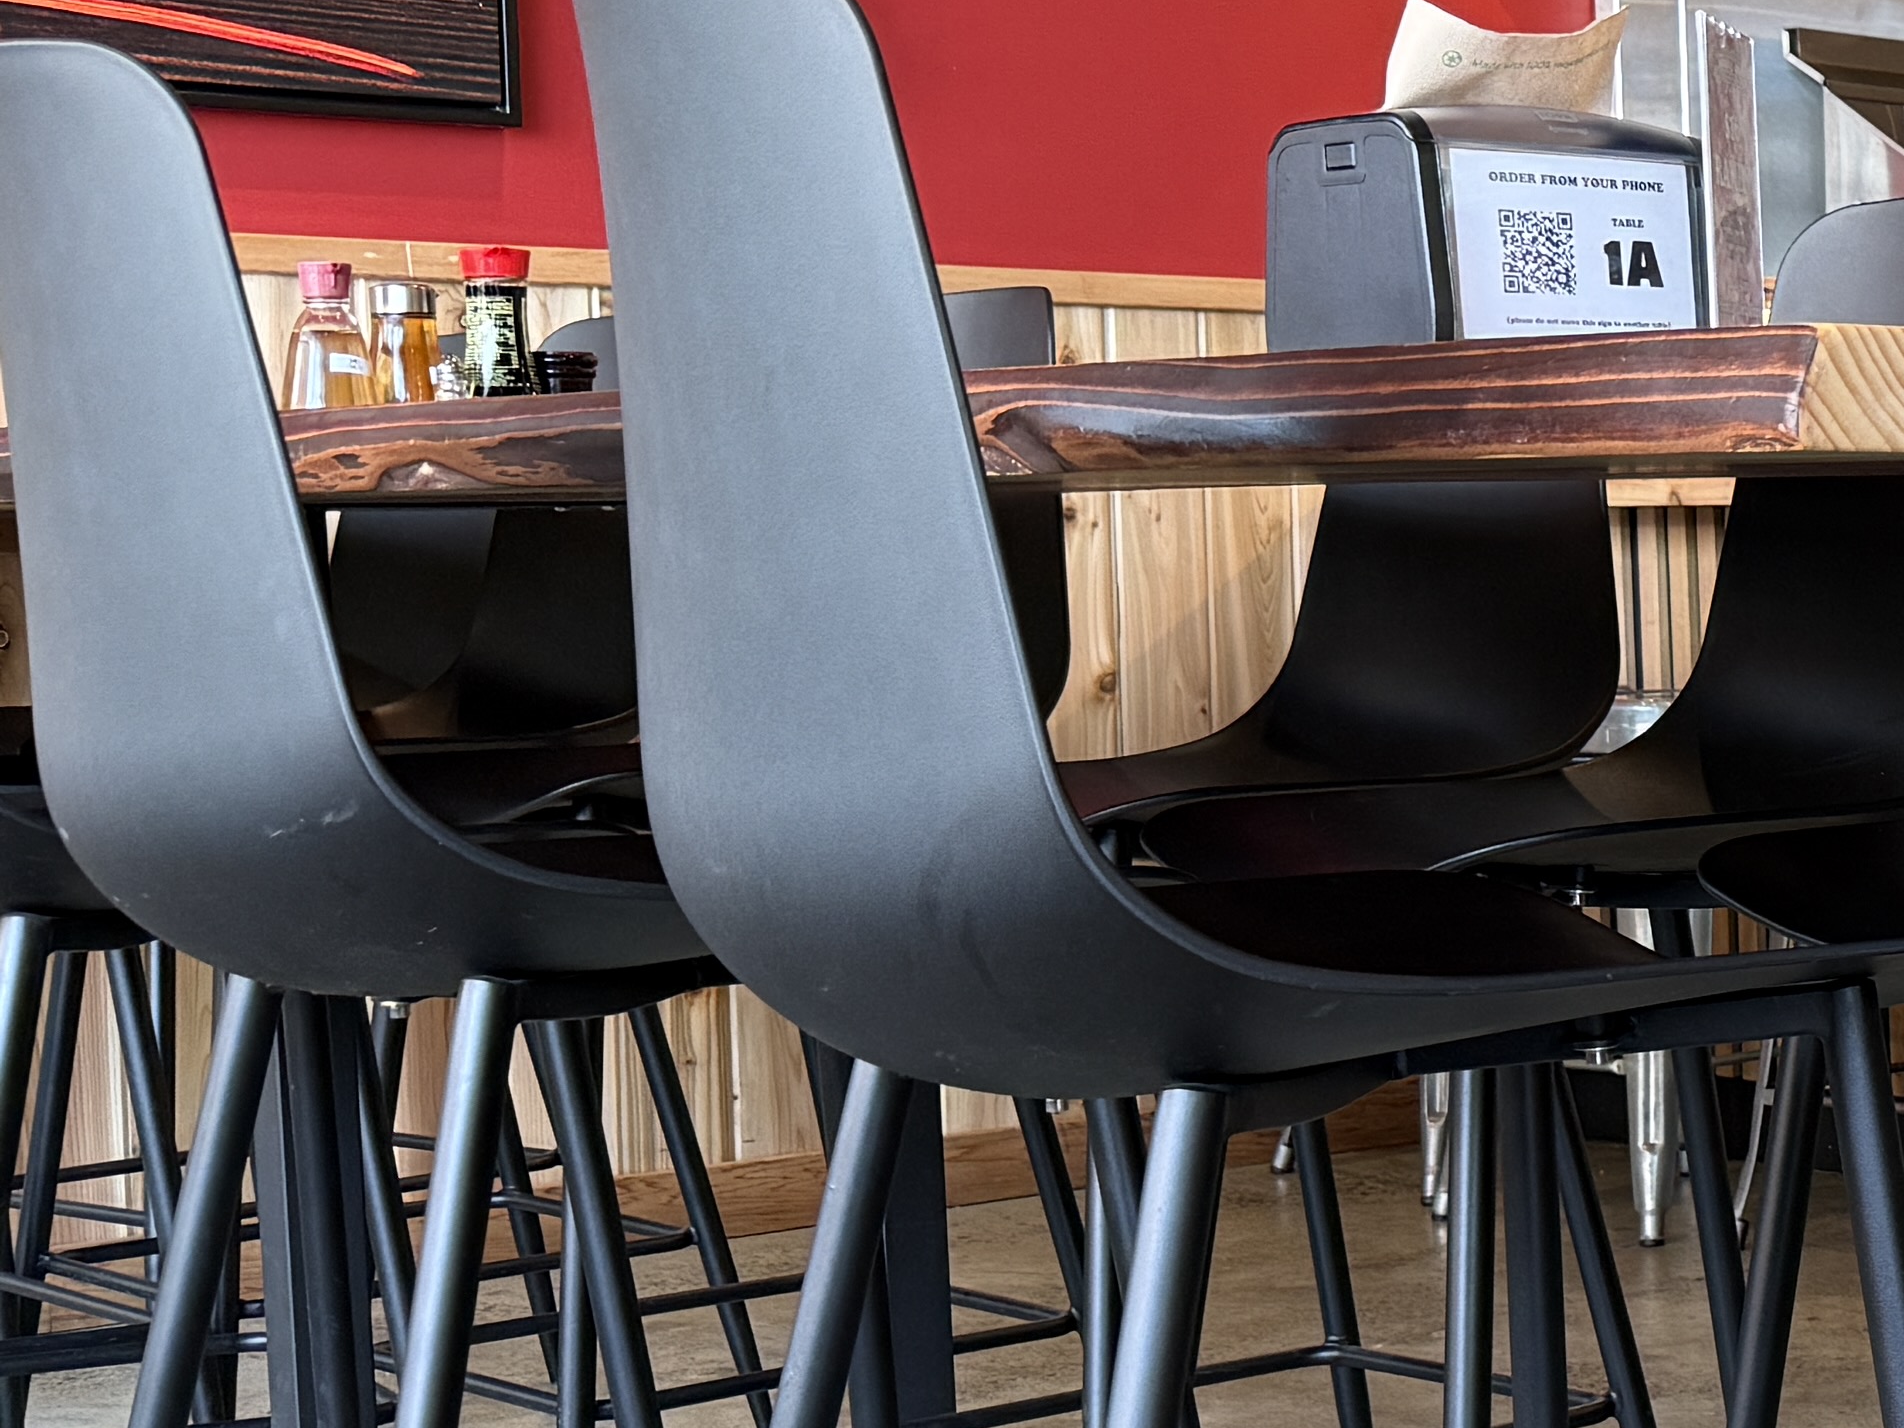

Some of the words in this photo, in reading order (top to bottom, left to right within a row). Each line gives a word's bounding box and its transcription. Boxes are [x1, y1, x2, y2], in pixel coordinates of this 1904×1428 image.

[1488, 171, 1537, 184] ORDER
[1540, 174, 1578, 188] FROM
[1581, 176, 1619, 190] YOUR
[1622, 180, 1664, 193] PHONE
[1611, 217, 1644, 229] TABLE
[1603, 240, 1664, 288] 1A
